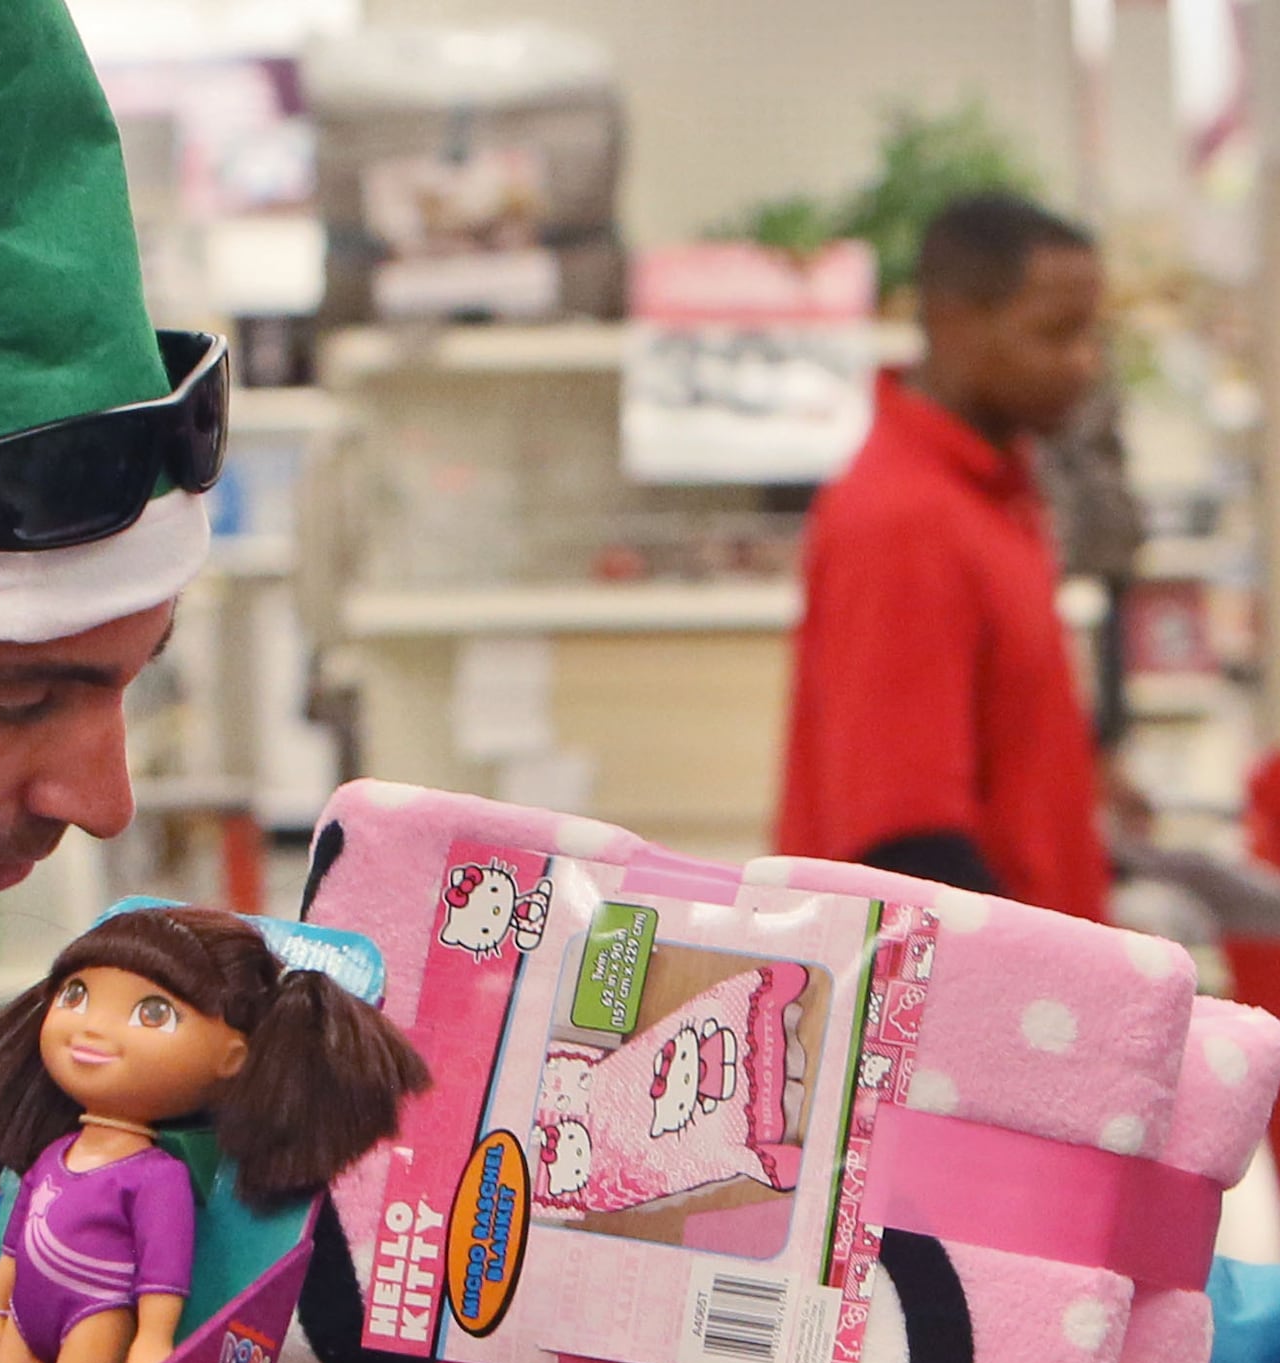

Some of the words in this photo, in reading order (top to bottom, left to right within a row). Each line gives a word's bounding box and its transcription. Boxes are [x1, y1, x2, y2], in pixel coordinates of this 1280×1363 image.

[610, 942, 624, 961] 90
[623, 938, 639, 964] 229
[601, 989, 615, 1008] 62
[607, 974, 618, 987] in
[620, 977, 632, 998] cm
[472, 1143, 504, 1240] RASCHEL
[485, 1184, 516, 1282] BLANKET
[369, 1201, 414, 1337] HELLO
[399, 1200, 444, 1342] KITTY
[461, 1243, 487, 1319] MICRO
